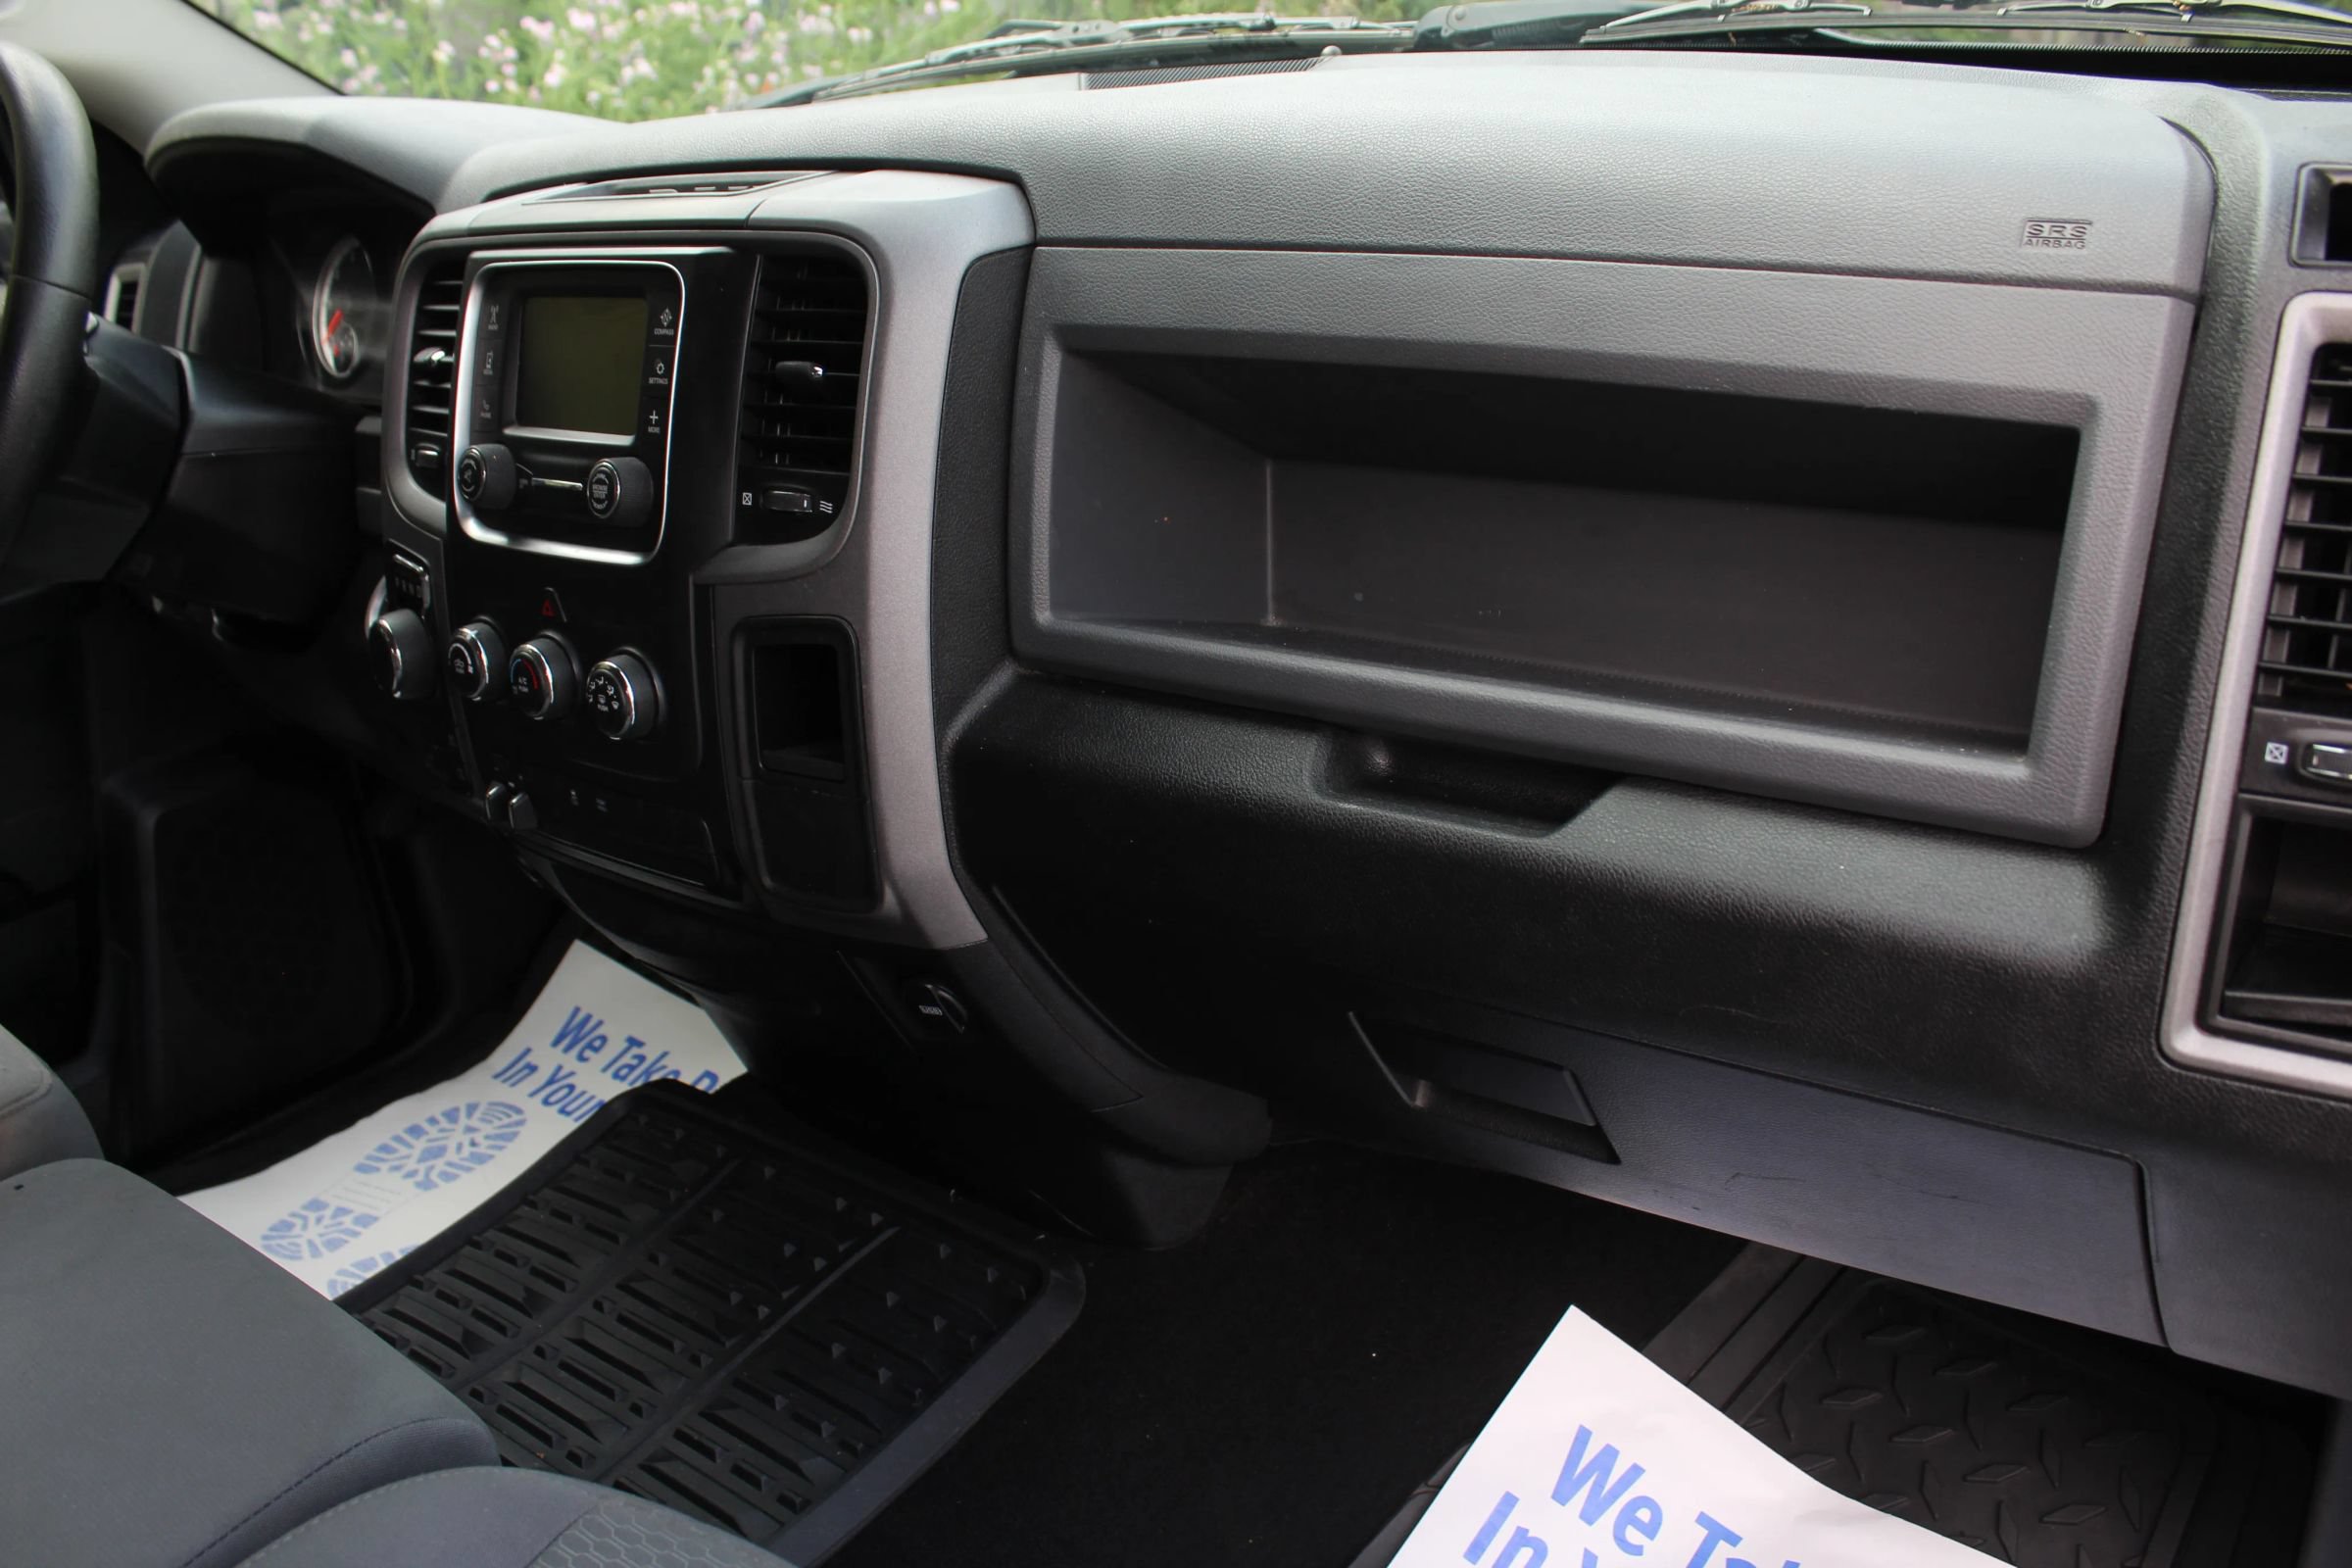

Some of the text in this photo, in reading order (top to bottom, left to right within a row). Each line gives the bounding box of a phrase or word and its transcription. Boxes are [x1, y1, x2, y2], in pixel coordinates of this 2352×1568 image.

[2022, 238, 2087, 250] AIRBAG
[2027, 223, 2087, 238] SRS
[550, 1005, 609, 1063] We
[492, 1047, 539, 1088] In
[1550, 1424, 1664, 1556] We
[1462, 1491, 1548, 1568] In
